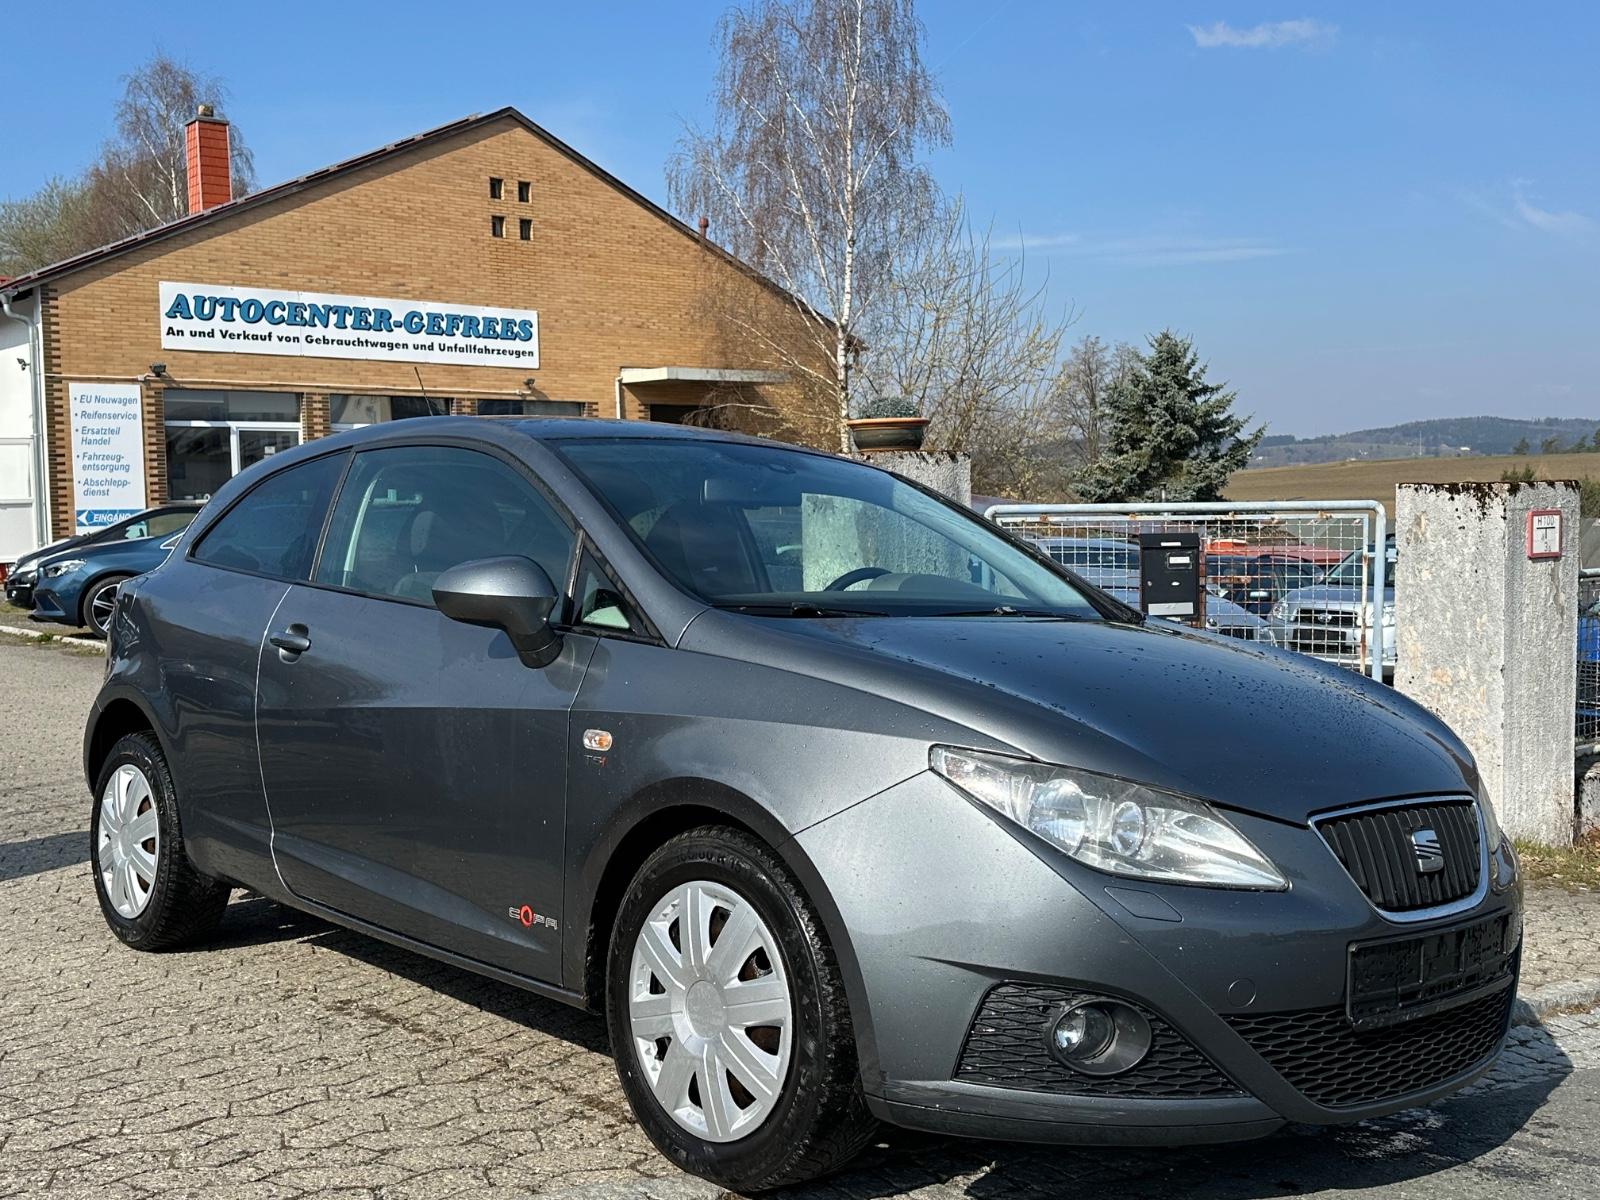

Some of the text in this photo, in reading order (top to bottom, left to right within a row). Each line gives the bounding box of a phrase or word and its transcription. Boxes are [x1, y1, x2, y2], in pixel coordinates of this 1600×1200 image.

[165, 293, 533, 341] AUTOCENTER-GEFREES
[166, 326, 534, 359] An und Verkauf von Gebrauchtwagen und Unfallfahrzeugen
[79, 394, 138, 407] EU Neuwagen
[80, 410, 138, 421] Reifenservice
[81, 426, 121, 436] Ersatzteil
[81, 436, 111, 446] Handel
[82, 452, 125, 463] Fahrzeug-
[82, 463, 131, 473] entsorgung
[83, 478, 131, 489] Abschlepp-
[83, 488, 110, 497] dienst
